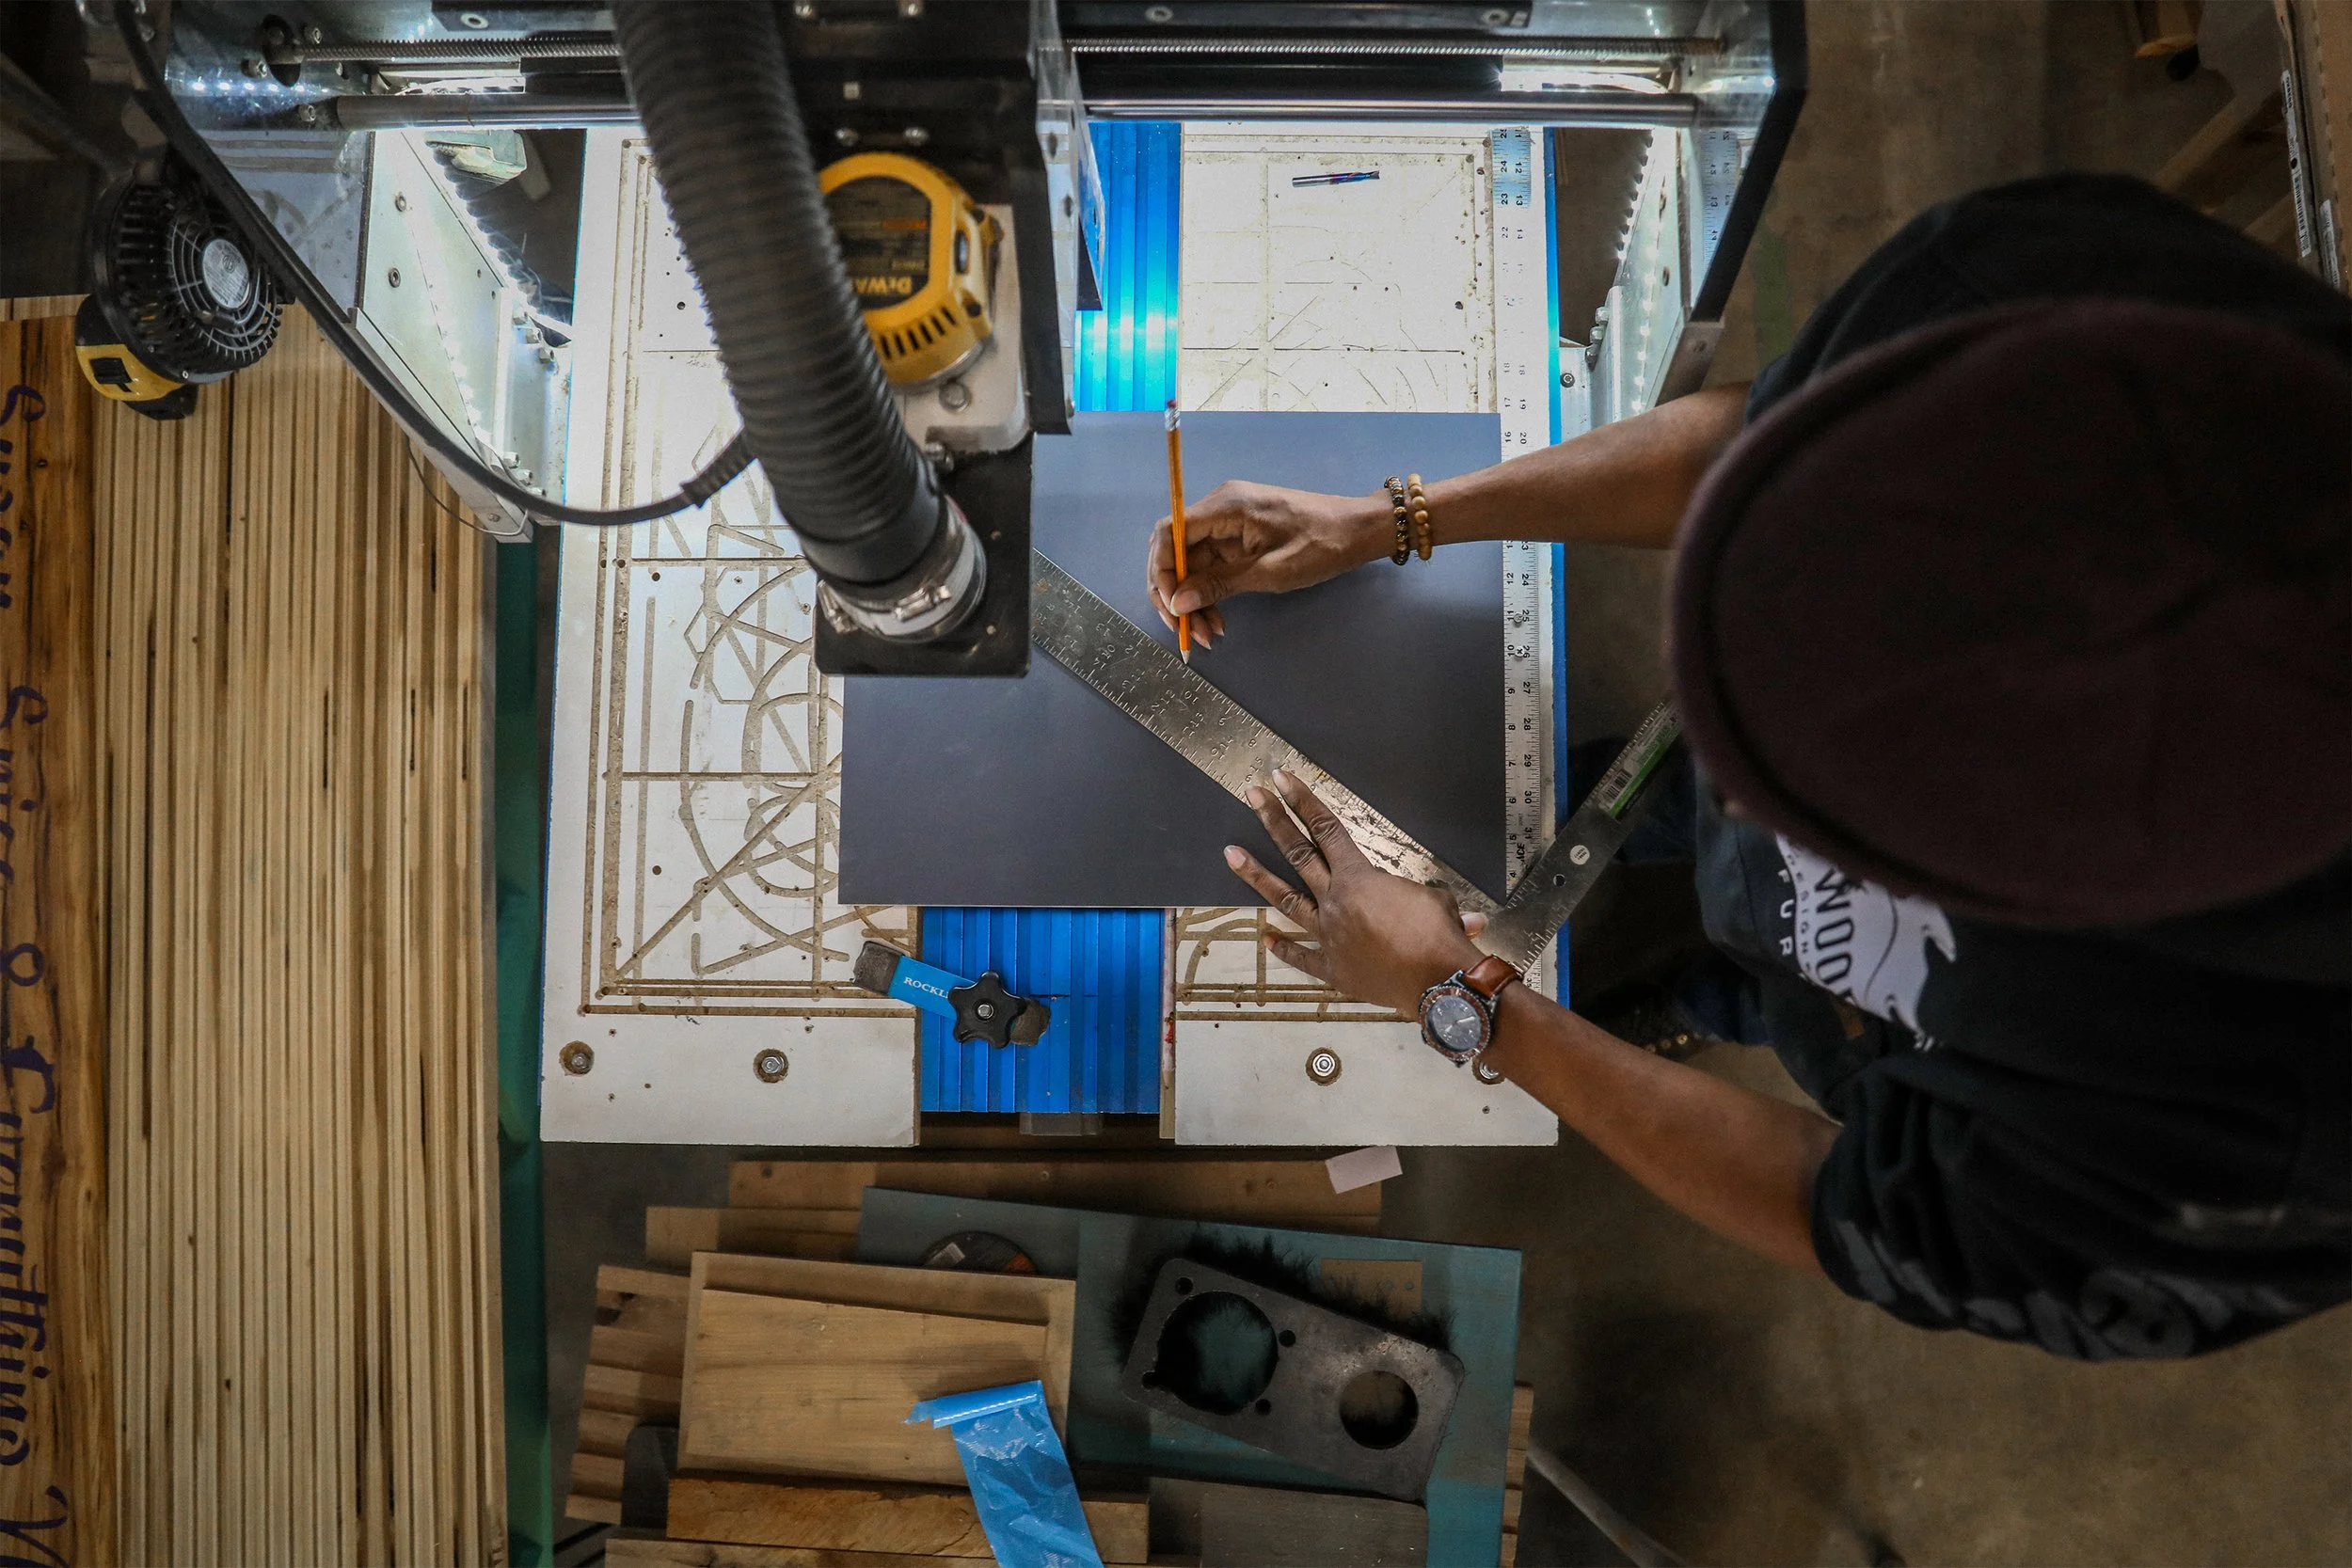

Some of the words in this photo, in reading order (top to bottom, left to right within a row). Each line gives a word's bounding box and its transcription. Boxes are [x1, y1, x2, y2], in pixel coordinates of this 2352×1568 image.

[1501, 160, 1507, 173] 24
[1515, 162, 1522, 173] 12
[1501, 193, 1508, 205] 23
[1517, 195, 1523, 206] 13
[1502, 227, 1508, 238] 22
[852, 277, 912, 294] DEWA
[1504, 397, 1511, 407] 17
[1520, 399, 1526, 410] 19
[1504, 432, 1512, 443] 16
[1520, 432, 1527, 445] 20
[1506, 572, 1514, 585] 12
[1521, 573, 1529, 586] 24
[1507, 610, 1514, 622] 11
[1522, 610, 1530, 623] 25
[1507, 644, 1515, 657] 10
[1523, 645, 1531, 658] 26
[1523, 681, 1531, 694] 27
[1184, 690, 1199, 705] 10
[1524, 718, 1532, 731] 28
[1524, 753, 1532, 768] 29
[1524, 790, 1533, 804] 30
[1525, 828, 1533, 839] 31
